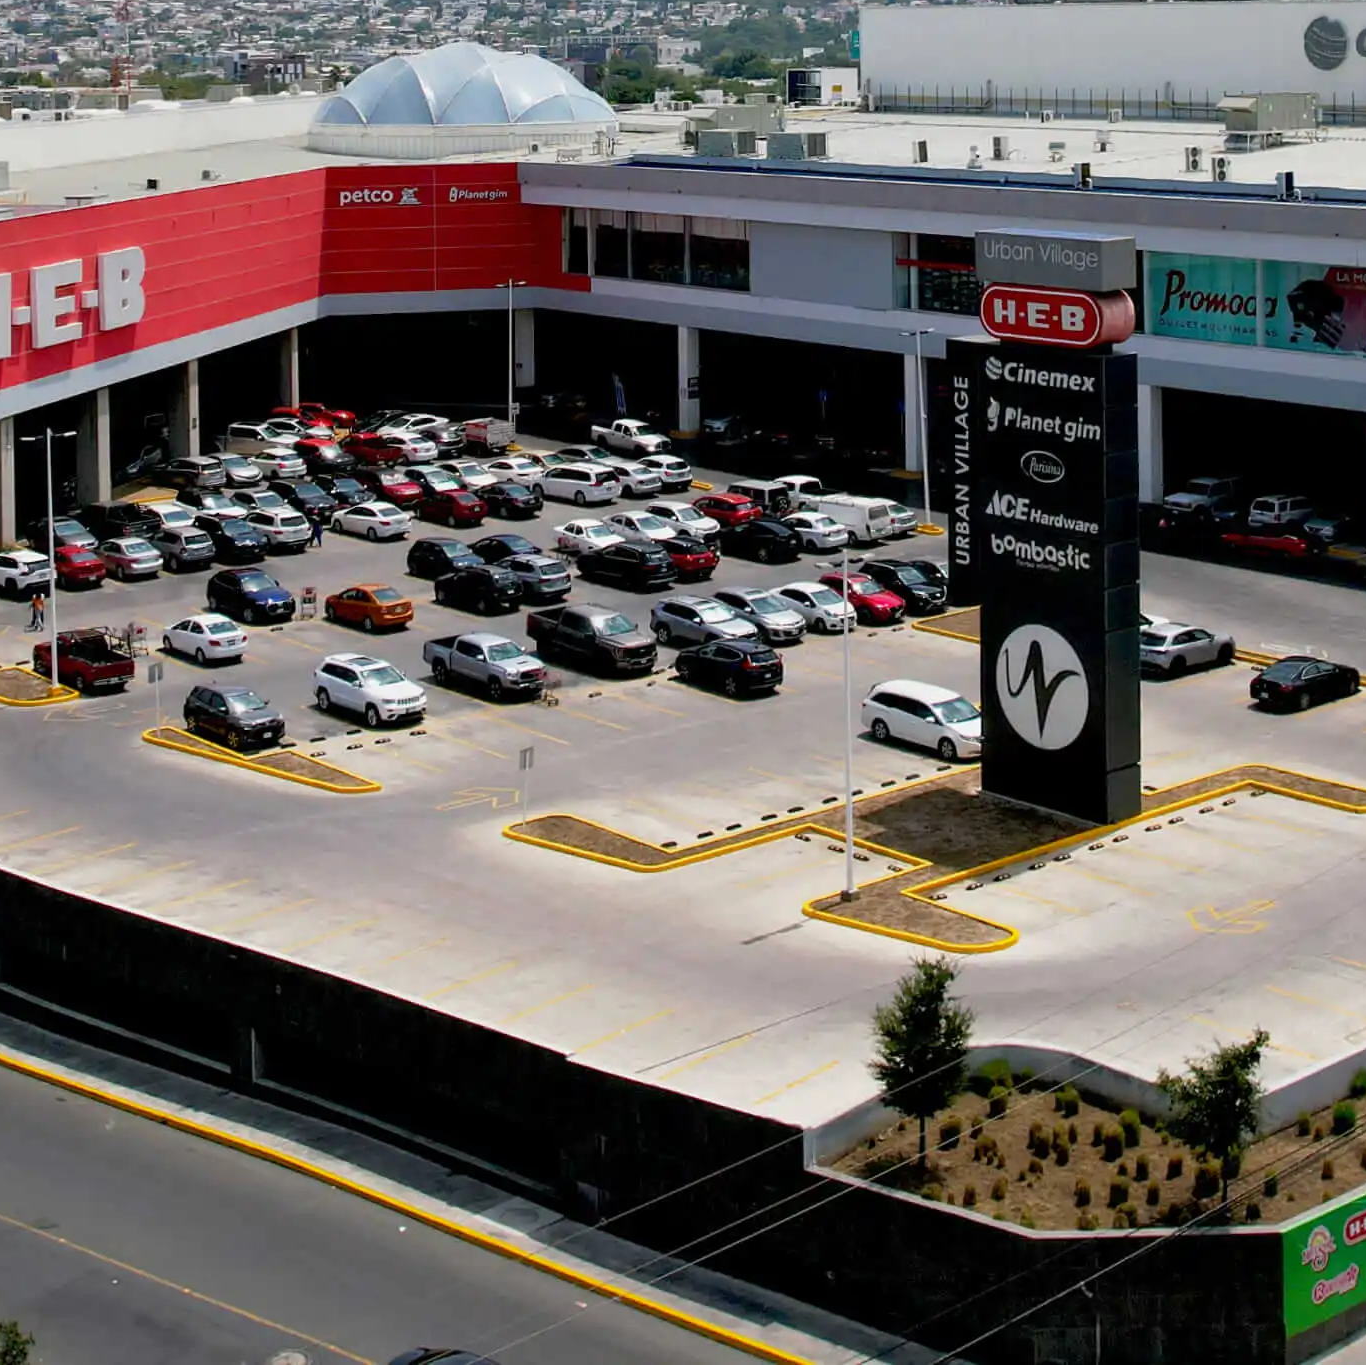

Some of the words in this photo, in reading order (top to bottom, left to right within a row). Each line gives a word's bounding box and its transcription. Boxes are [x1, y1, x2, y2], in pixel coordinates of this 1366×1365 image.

[339, 188, 393, 206] petco
[985, 239, 1033, 262] Urban
[1039, 243, 1098, 271] Village
[1004, 362, 1095, 392] Cinemex
[954, 376, 970, 474] VILLAGE
[1004, 407, 1061, 434] Planet
[1064, 417, 1101, 442] gim
[955, 484, 970, 565] URBAN
[985, 489, 1030, 520] ACE
[1030, 508, 1099, 534] Hardware
[991, 533, 1090, 570] bombastic
